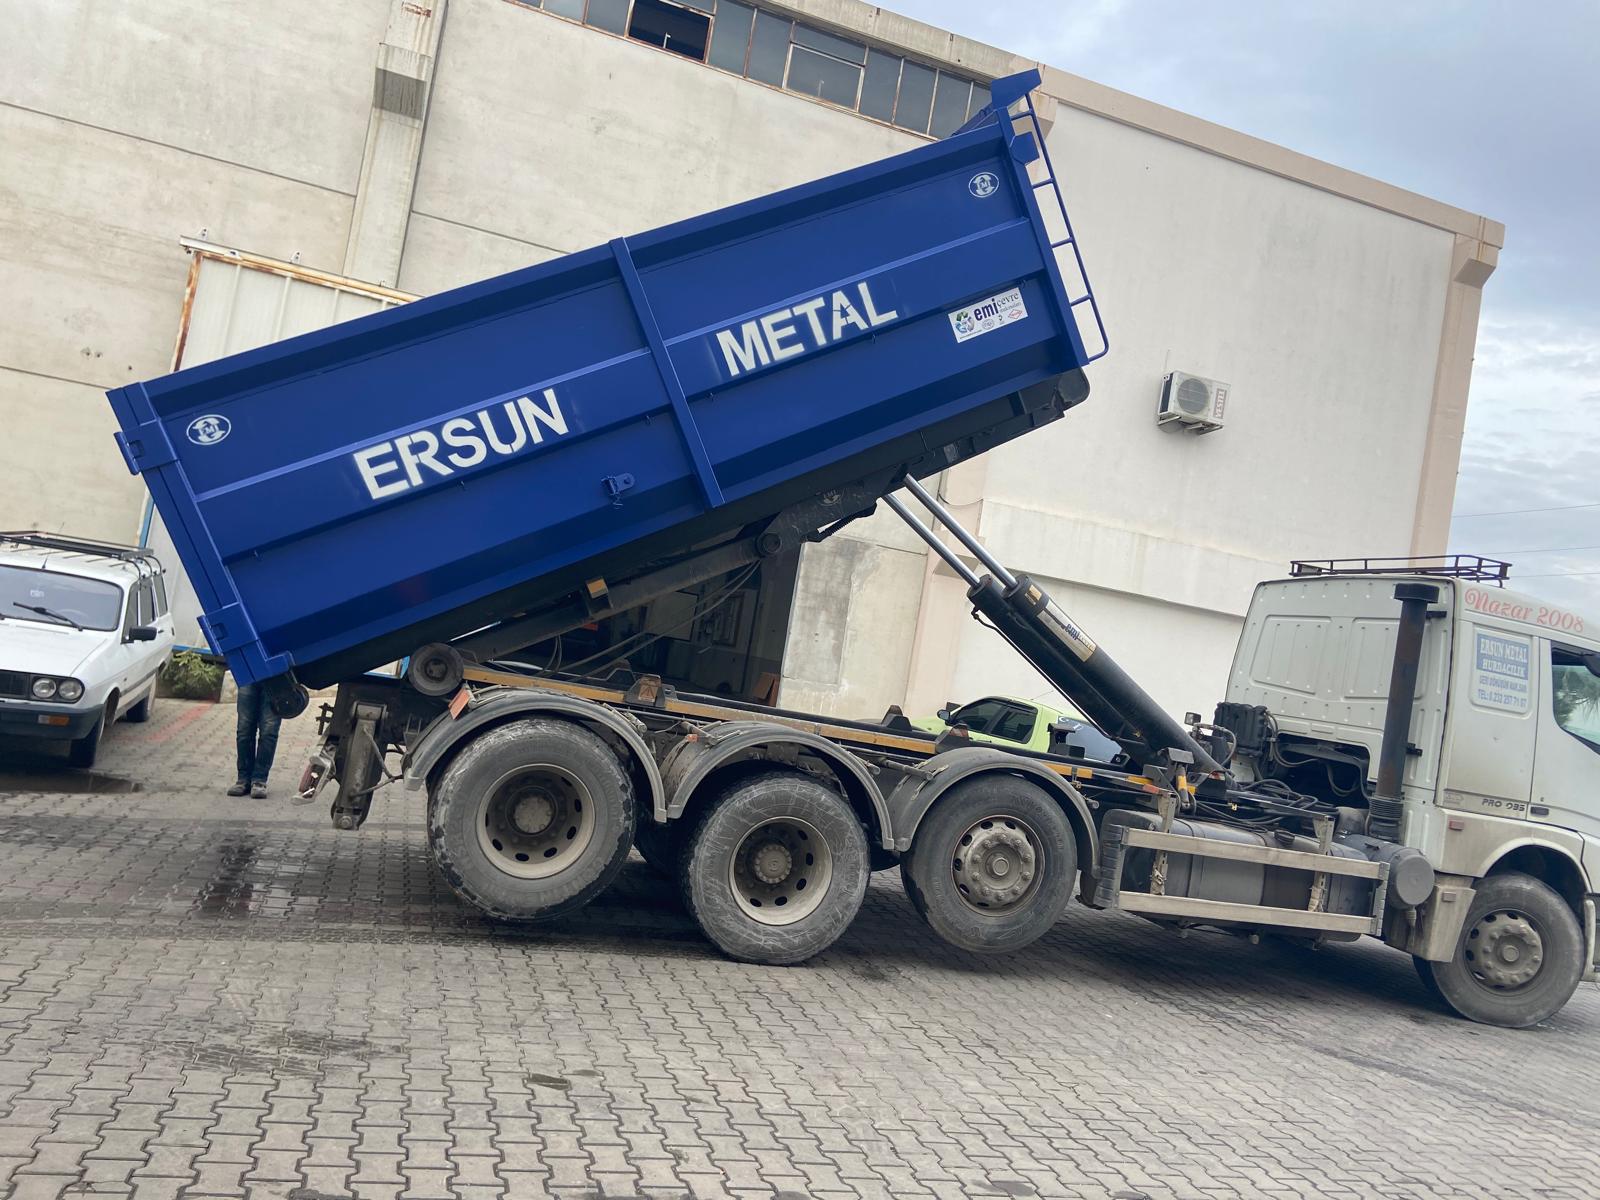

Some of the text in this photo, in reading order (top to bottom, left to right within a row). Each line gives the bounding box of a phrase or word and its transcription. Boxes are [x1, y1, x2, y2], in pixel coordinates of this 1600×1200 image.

[974, 298, 999, 321] emi
[997, 292, 1019, 308] çevre
[353, 282, 899, 499] ERSUN METAL
[1464, 588, 1584, 633] Nazar 2008
[1480, 638, 1527, 663] ERSUN METAL
[1482, 798, 1502, 808] PRO
